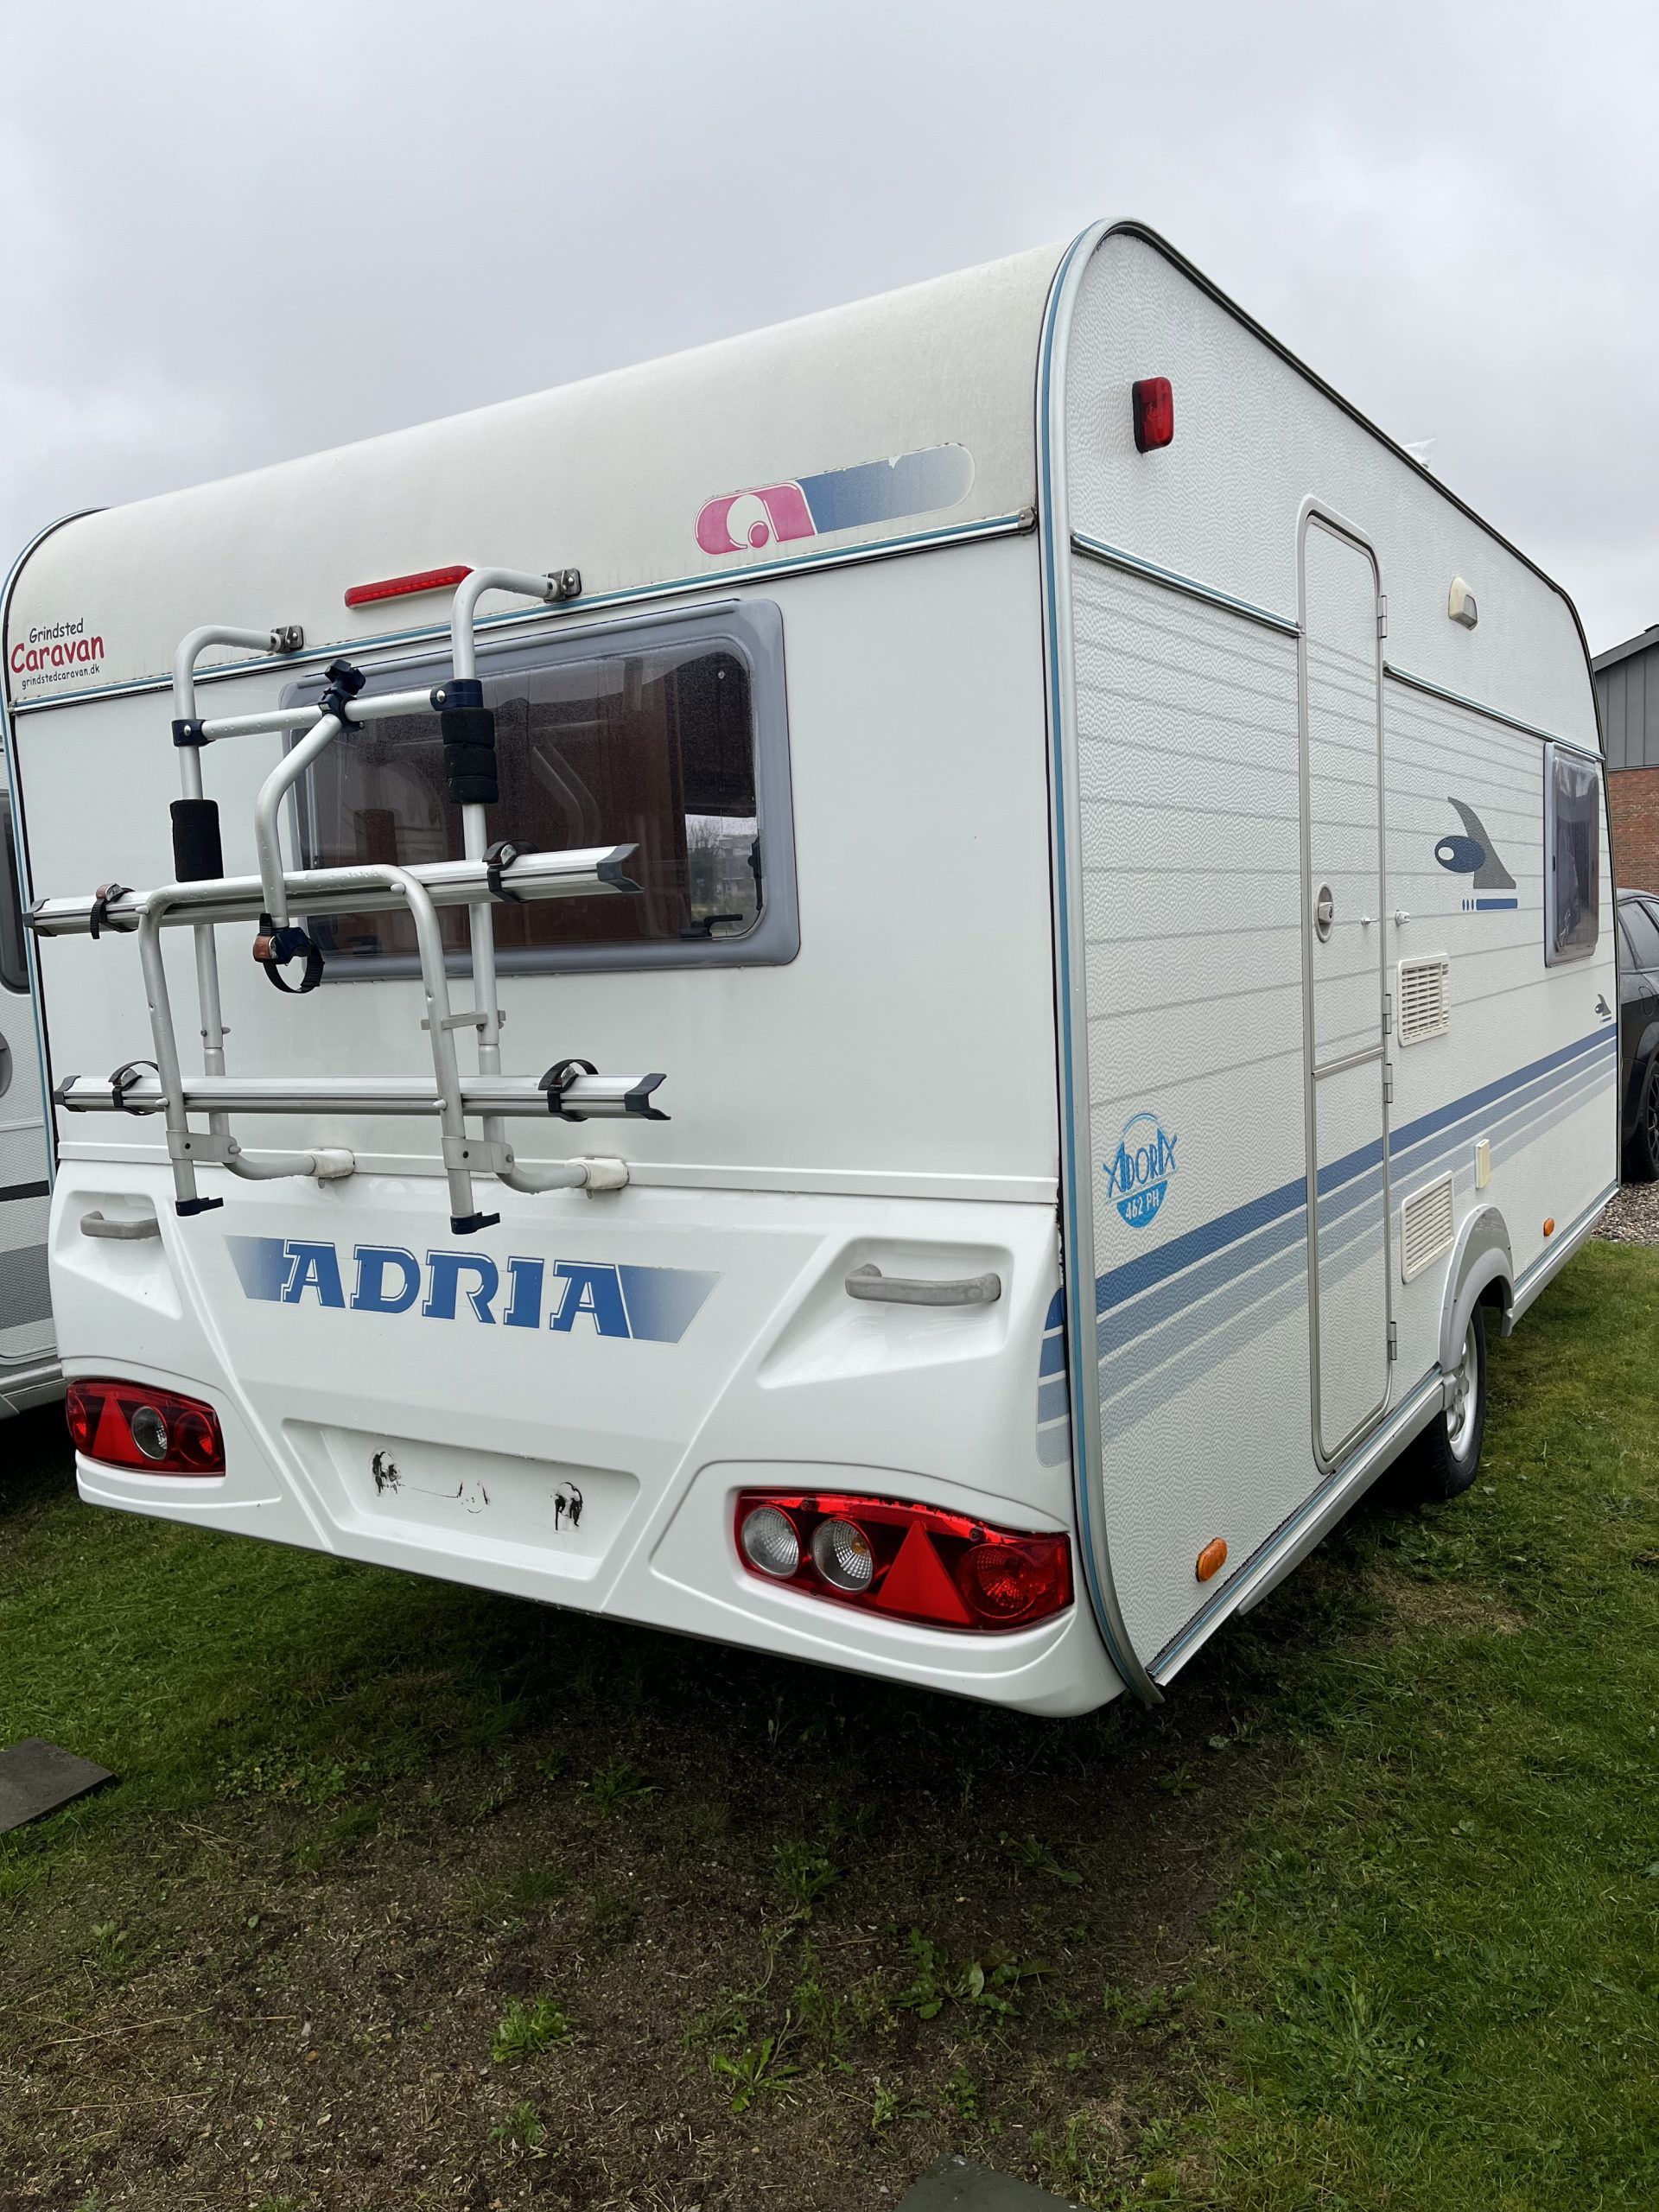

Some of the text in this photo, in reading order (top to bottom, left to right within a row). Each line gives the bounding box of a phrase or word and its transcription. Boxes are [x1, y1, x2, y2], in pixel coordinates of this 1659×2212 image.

[29, 617, 84, 643] Grindsted
[10, 636, 105, 673] Caravan
[22, 664, 100, 690] grindstedcaravan.dk
[1125, 1188, 1160, 1220] 462 PH
[281, 1238, 633, 1339] ADRIA
